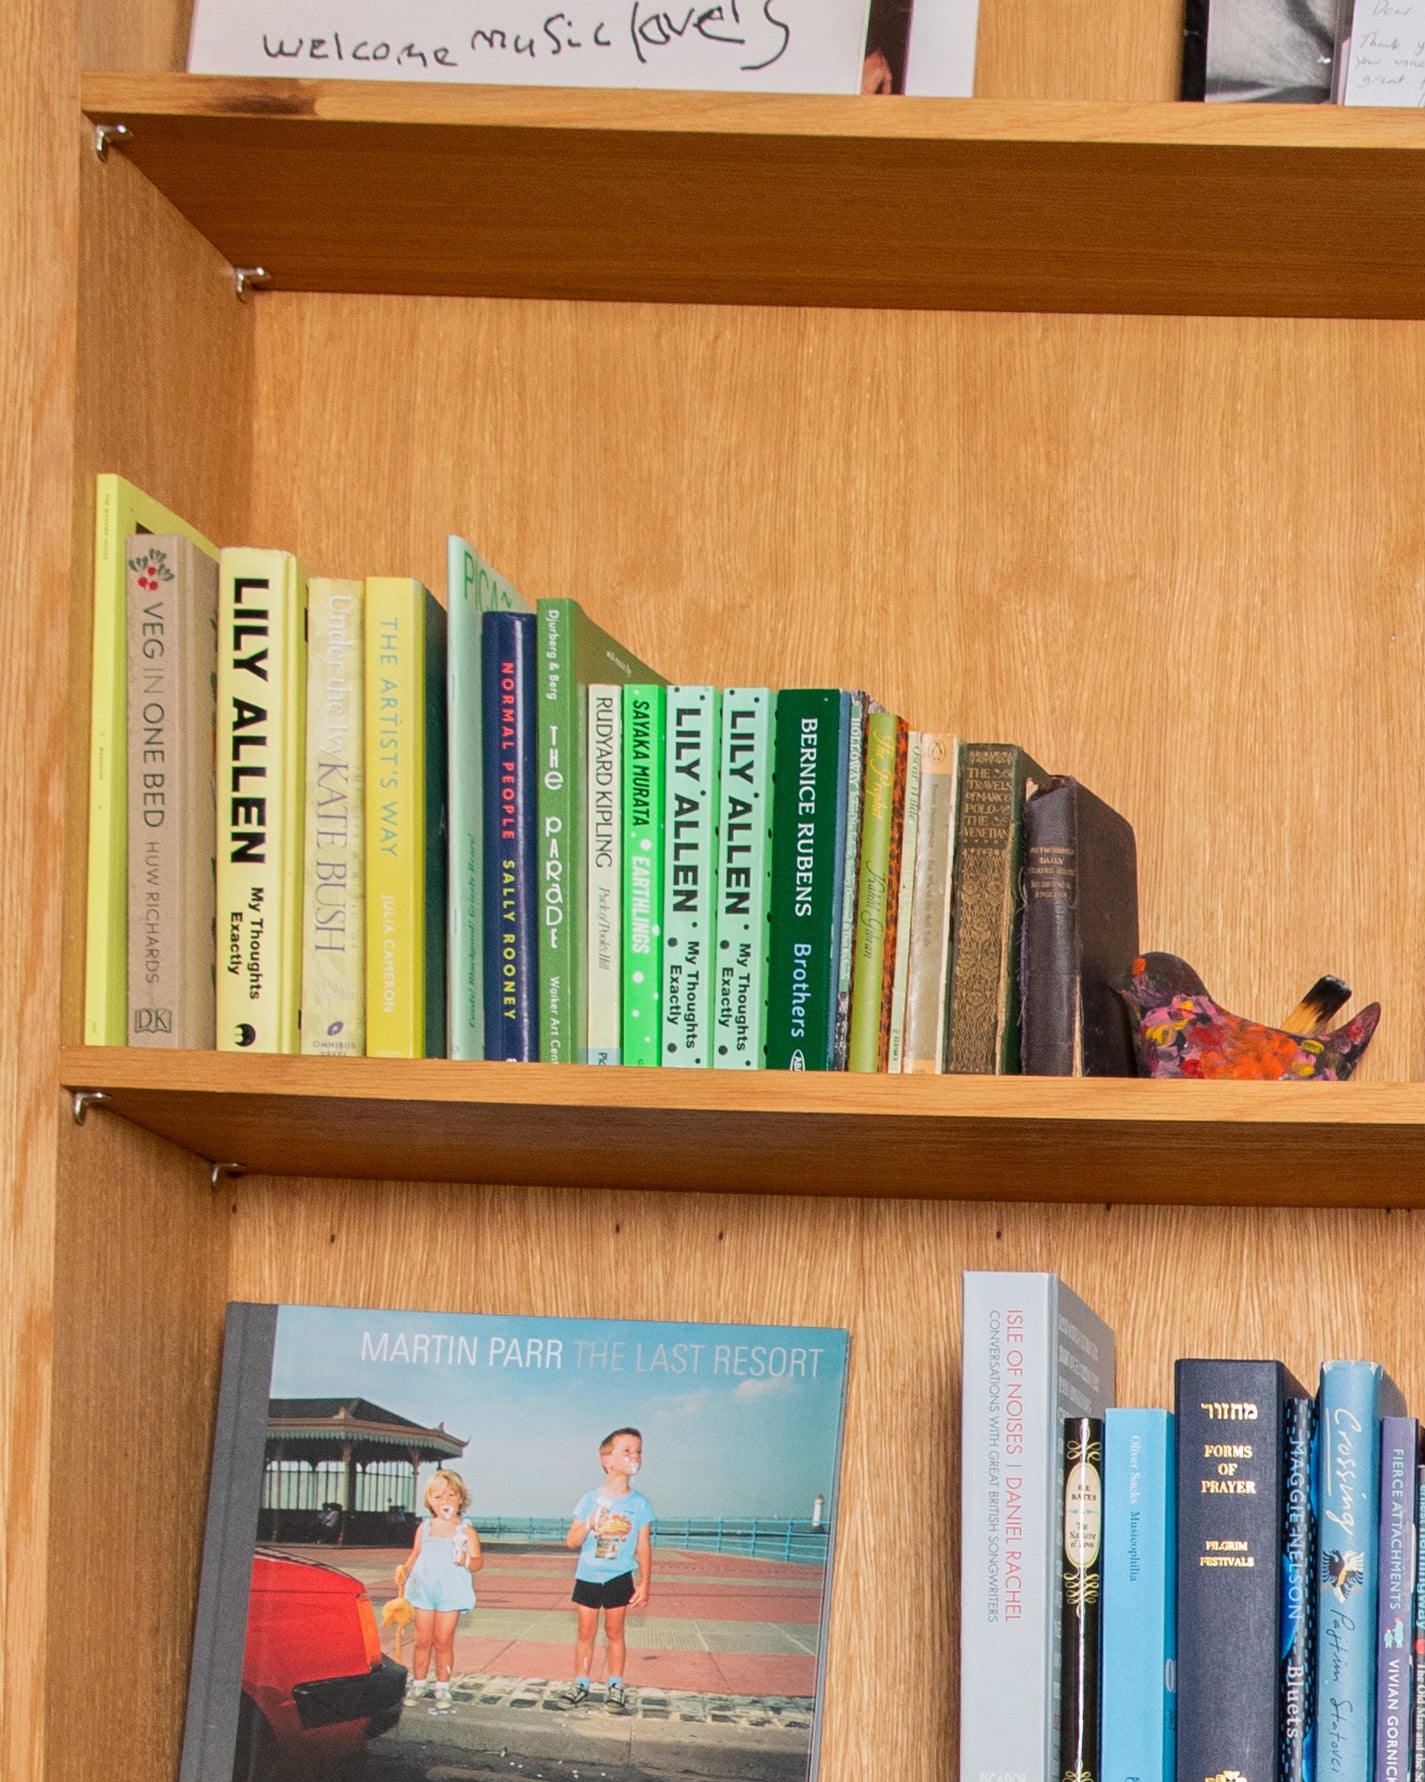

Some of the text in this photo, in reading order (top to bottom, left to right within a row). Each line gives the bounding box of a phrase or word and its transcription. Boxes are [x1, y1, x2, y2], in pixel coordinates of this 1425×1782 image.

[262, 31, 458, 67] welcome
[472, 17, 612, 61] music
[143, 602, 165, 983] VEG IN ONE BED HUW RICHARDS
[231, 577, 269, 864] LILY ALLEN
[380, 617, 399, 856] THE ARTIST'S WAY
[501, 662, 516, 1020] NORMAL PEOPLE SALLY ROONEY
[631, 700, 650, 953] SAYAKA MURATA EARTHLINGS
[228, 912, 243, 974] Exactly
[248, 888, 263, 999] My Thoughts
[790, 717, 817, 1037] BERNICE RUBENS Brothers
[361, 1330, 824, 1378] MARTIN PARR THE LAST RESORT
[1004, 1309, 1023, 1621] ISLE OF NOISES DANIEL RACHEL
